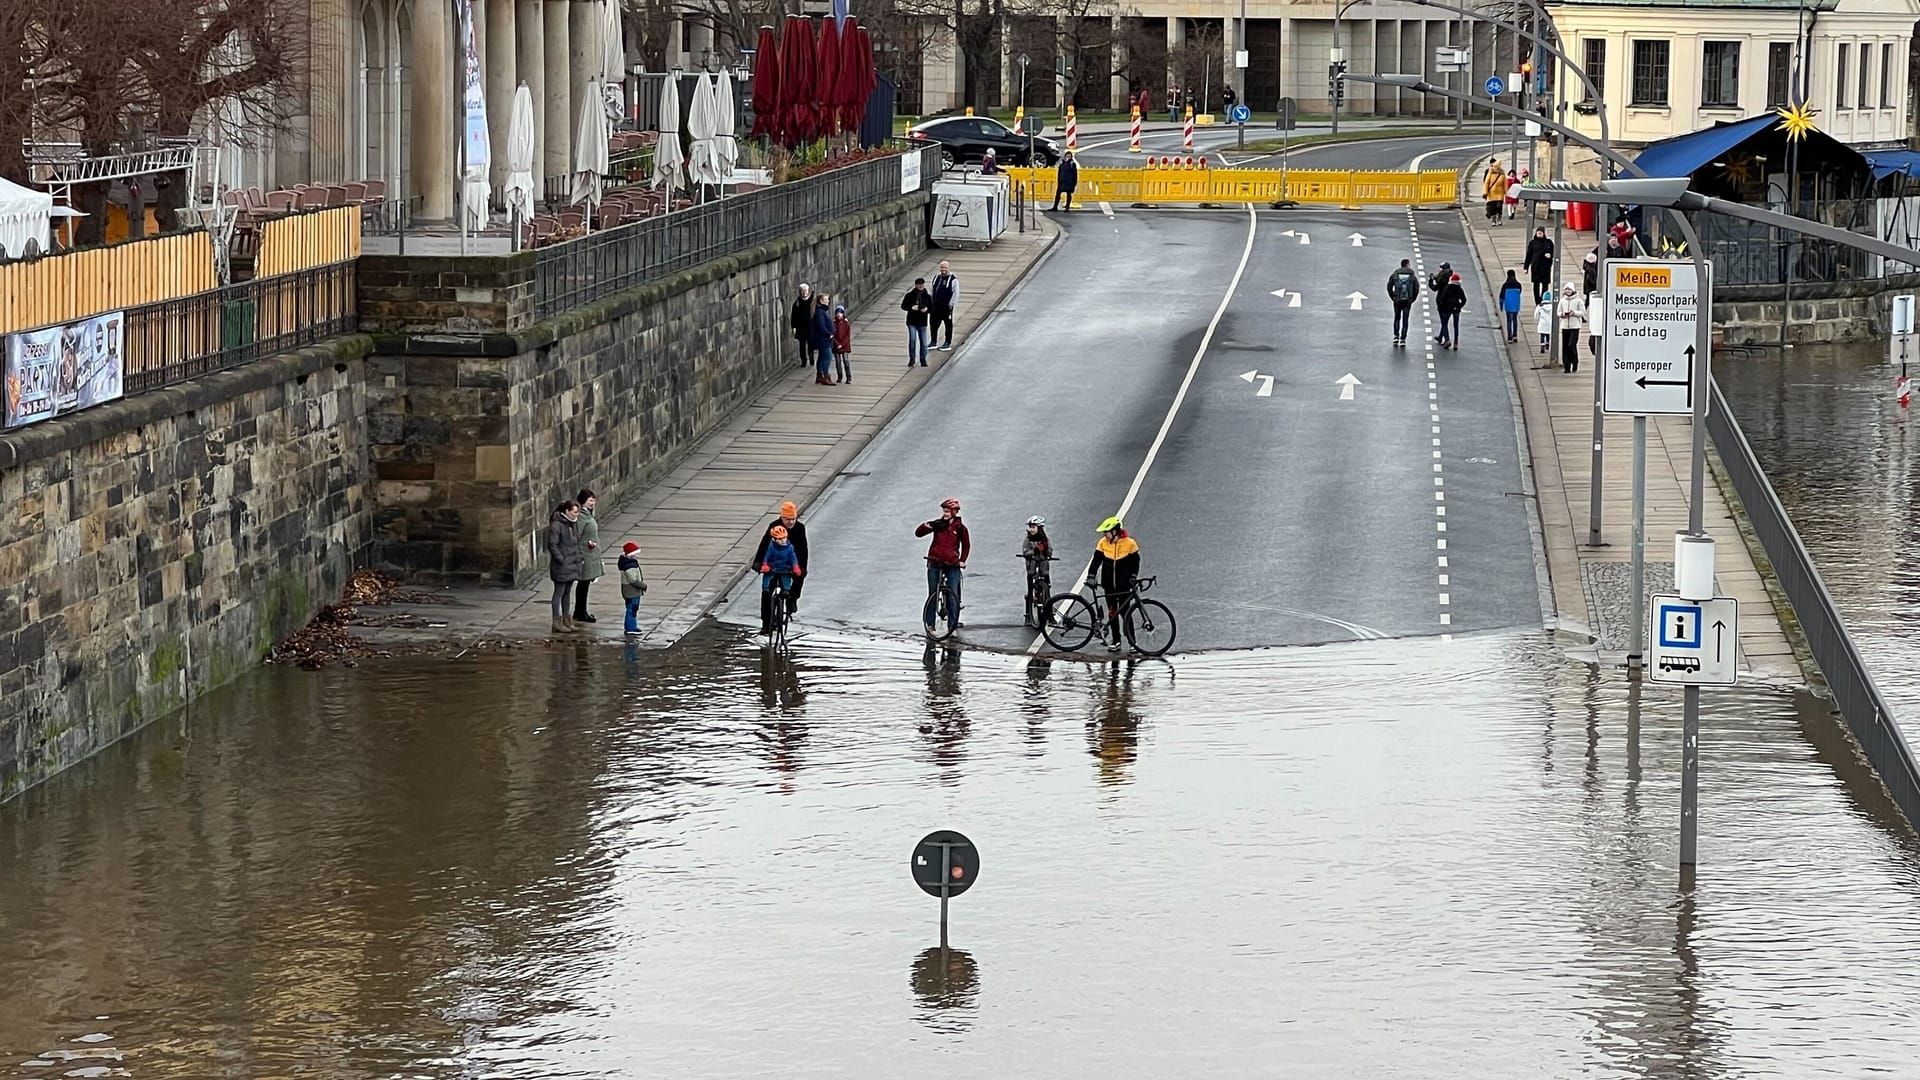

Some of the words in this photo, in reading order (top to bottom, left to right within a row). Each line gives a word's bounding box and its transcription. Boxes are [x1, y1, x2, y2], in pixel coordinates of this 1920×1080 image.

[1619, 271, 1668, 285] Meißen
[1615, 293, 1698, 308] Messe/Sportpark
[1614, 325, 1667, 340] Landtag
[1613, 358, 1673, 373] Semperoper
[20, 363, 52, 394] PARTY
